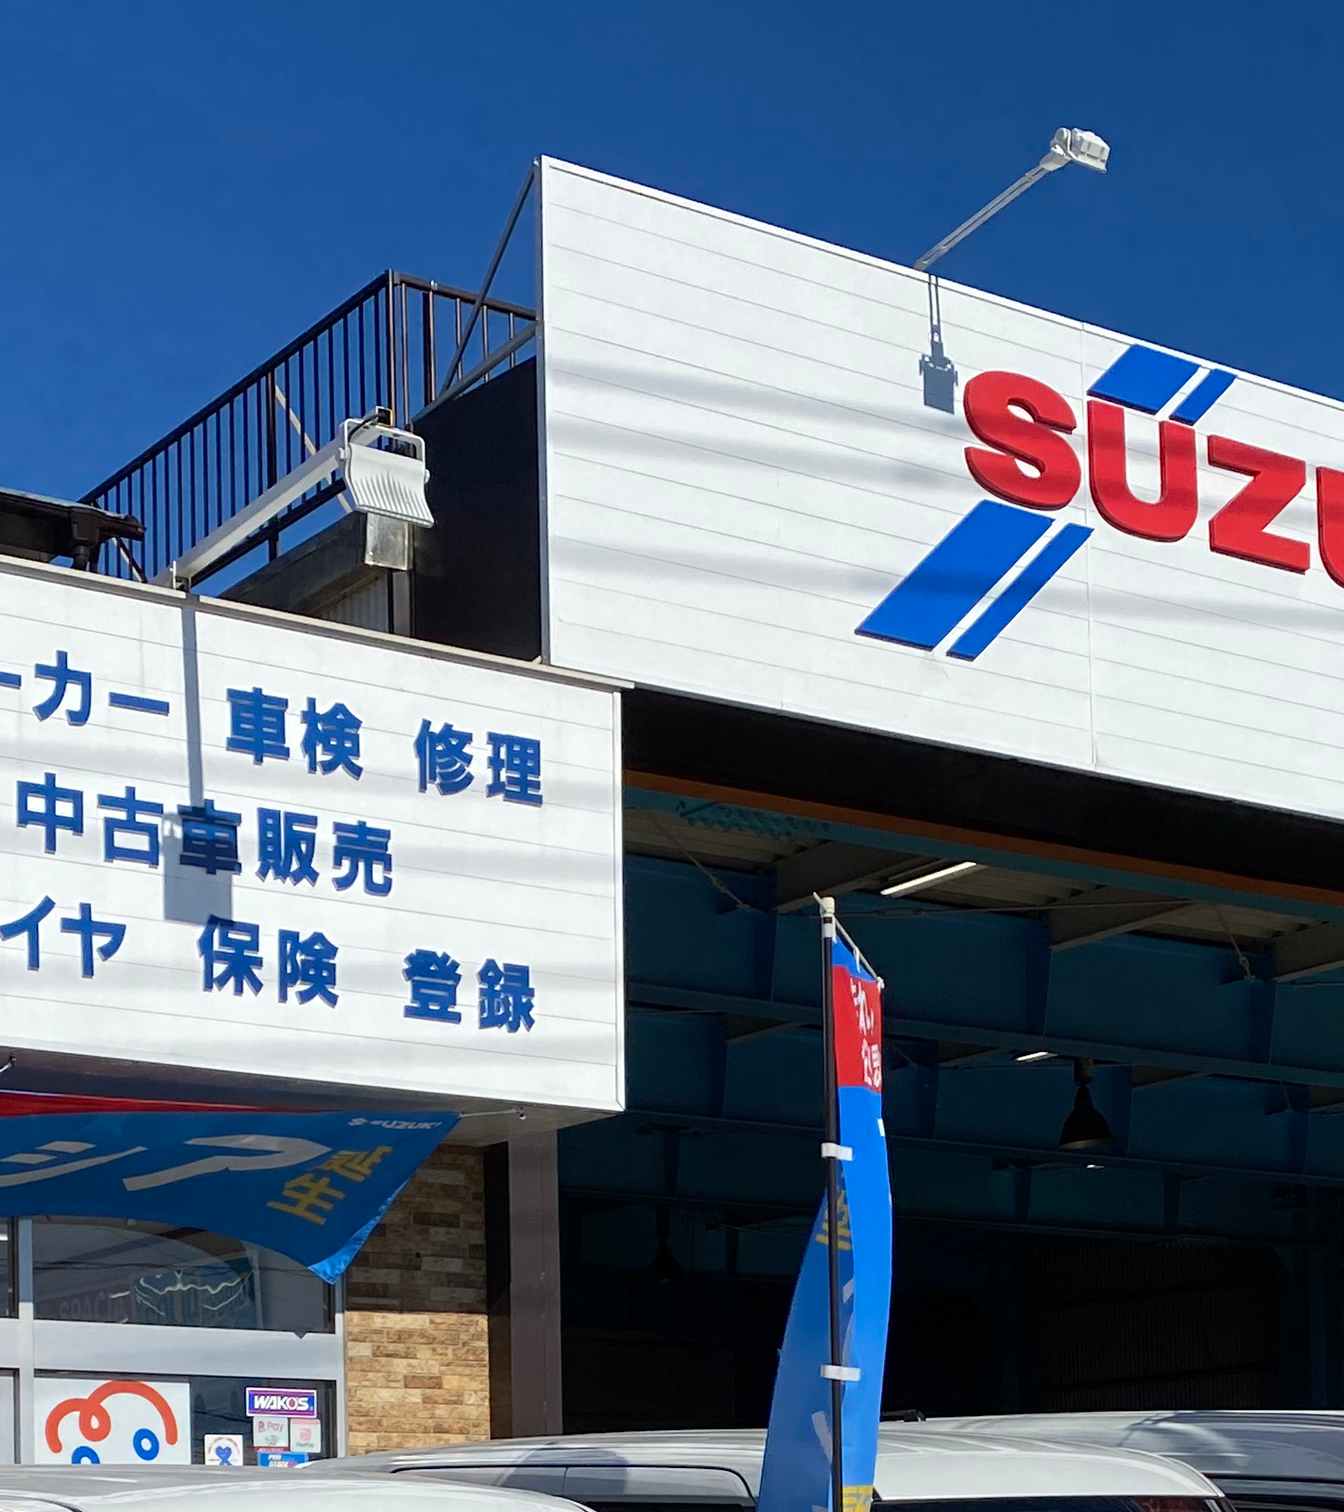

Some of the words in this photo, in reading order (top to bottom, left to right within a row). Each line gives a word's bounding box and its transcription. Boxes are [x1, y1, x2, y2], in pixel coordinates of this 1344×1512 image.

[224, 685, 364, 782] 車検
[413, 716, 544, 808] 修理
[15, 771, 394, 898] 中古車販売
[197, 912, 340, 1008] 保険
[402, 946, 535, 1034] 登録
